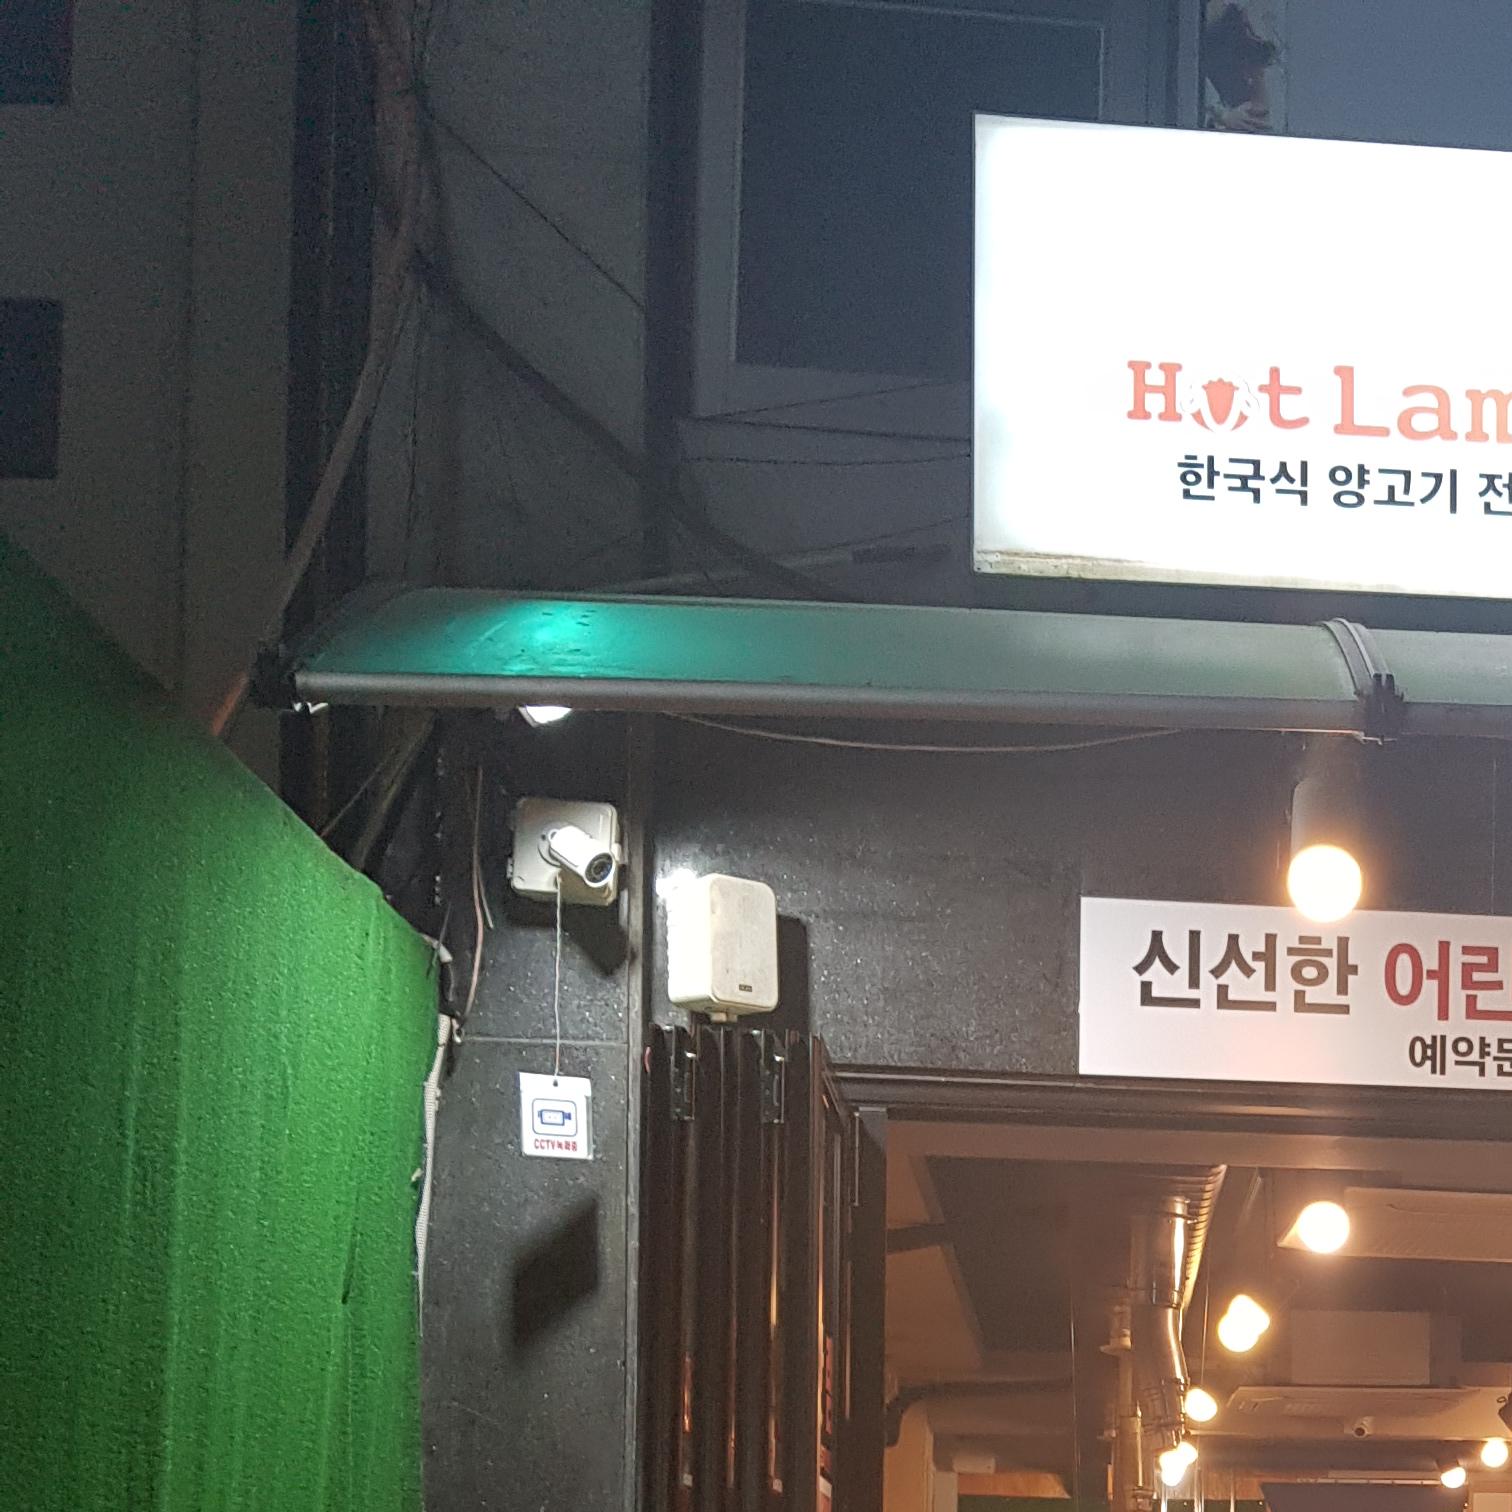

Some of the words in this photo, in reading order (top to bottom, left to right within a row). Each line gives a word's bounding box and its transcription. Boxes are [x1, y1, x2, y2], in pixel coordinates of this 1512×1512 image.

[1178, 455, 1307, 506] 한국식
[1329, 464, 1457, 513] 양고기
[1133, 930, 1358, 1014] 신선한
